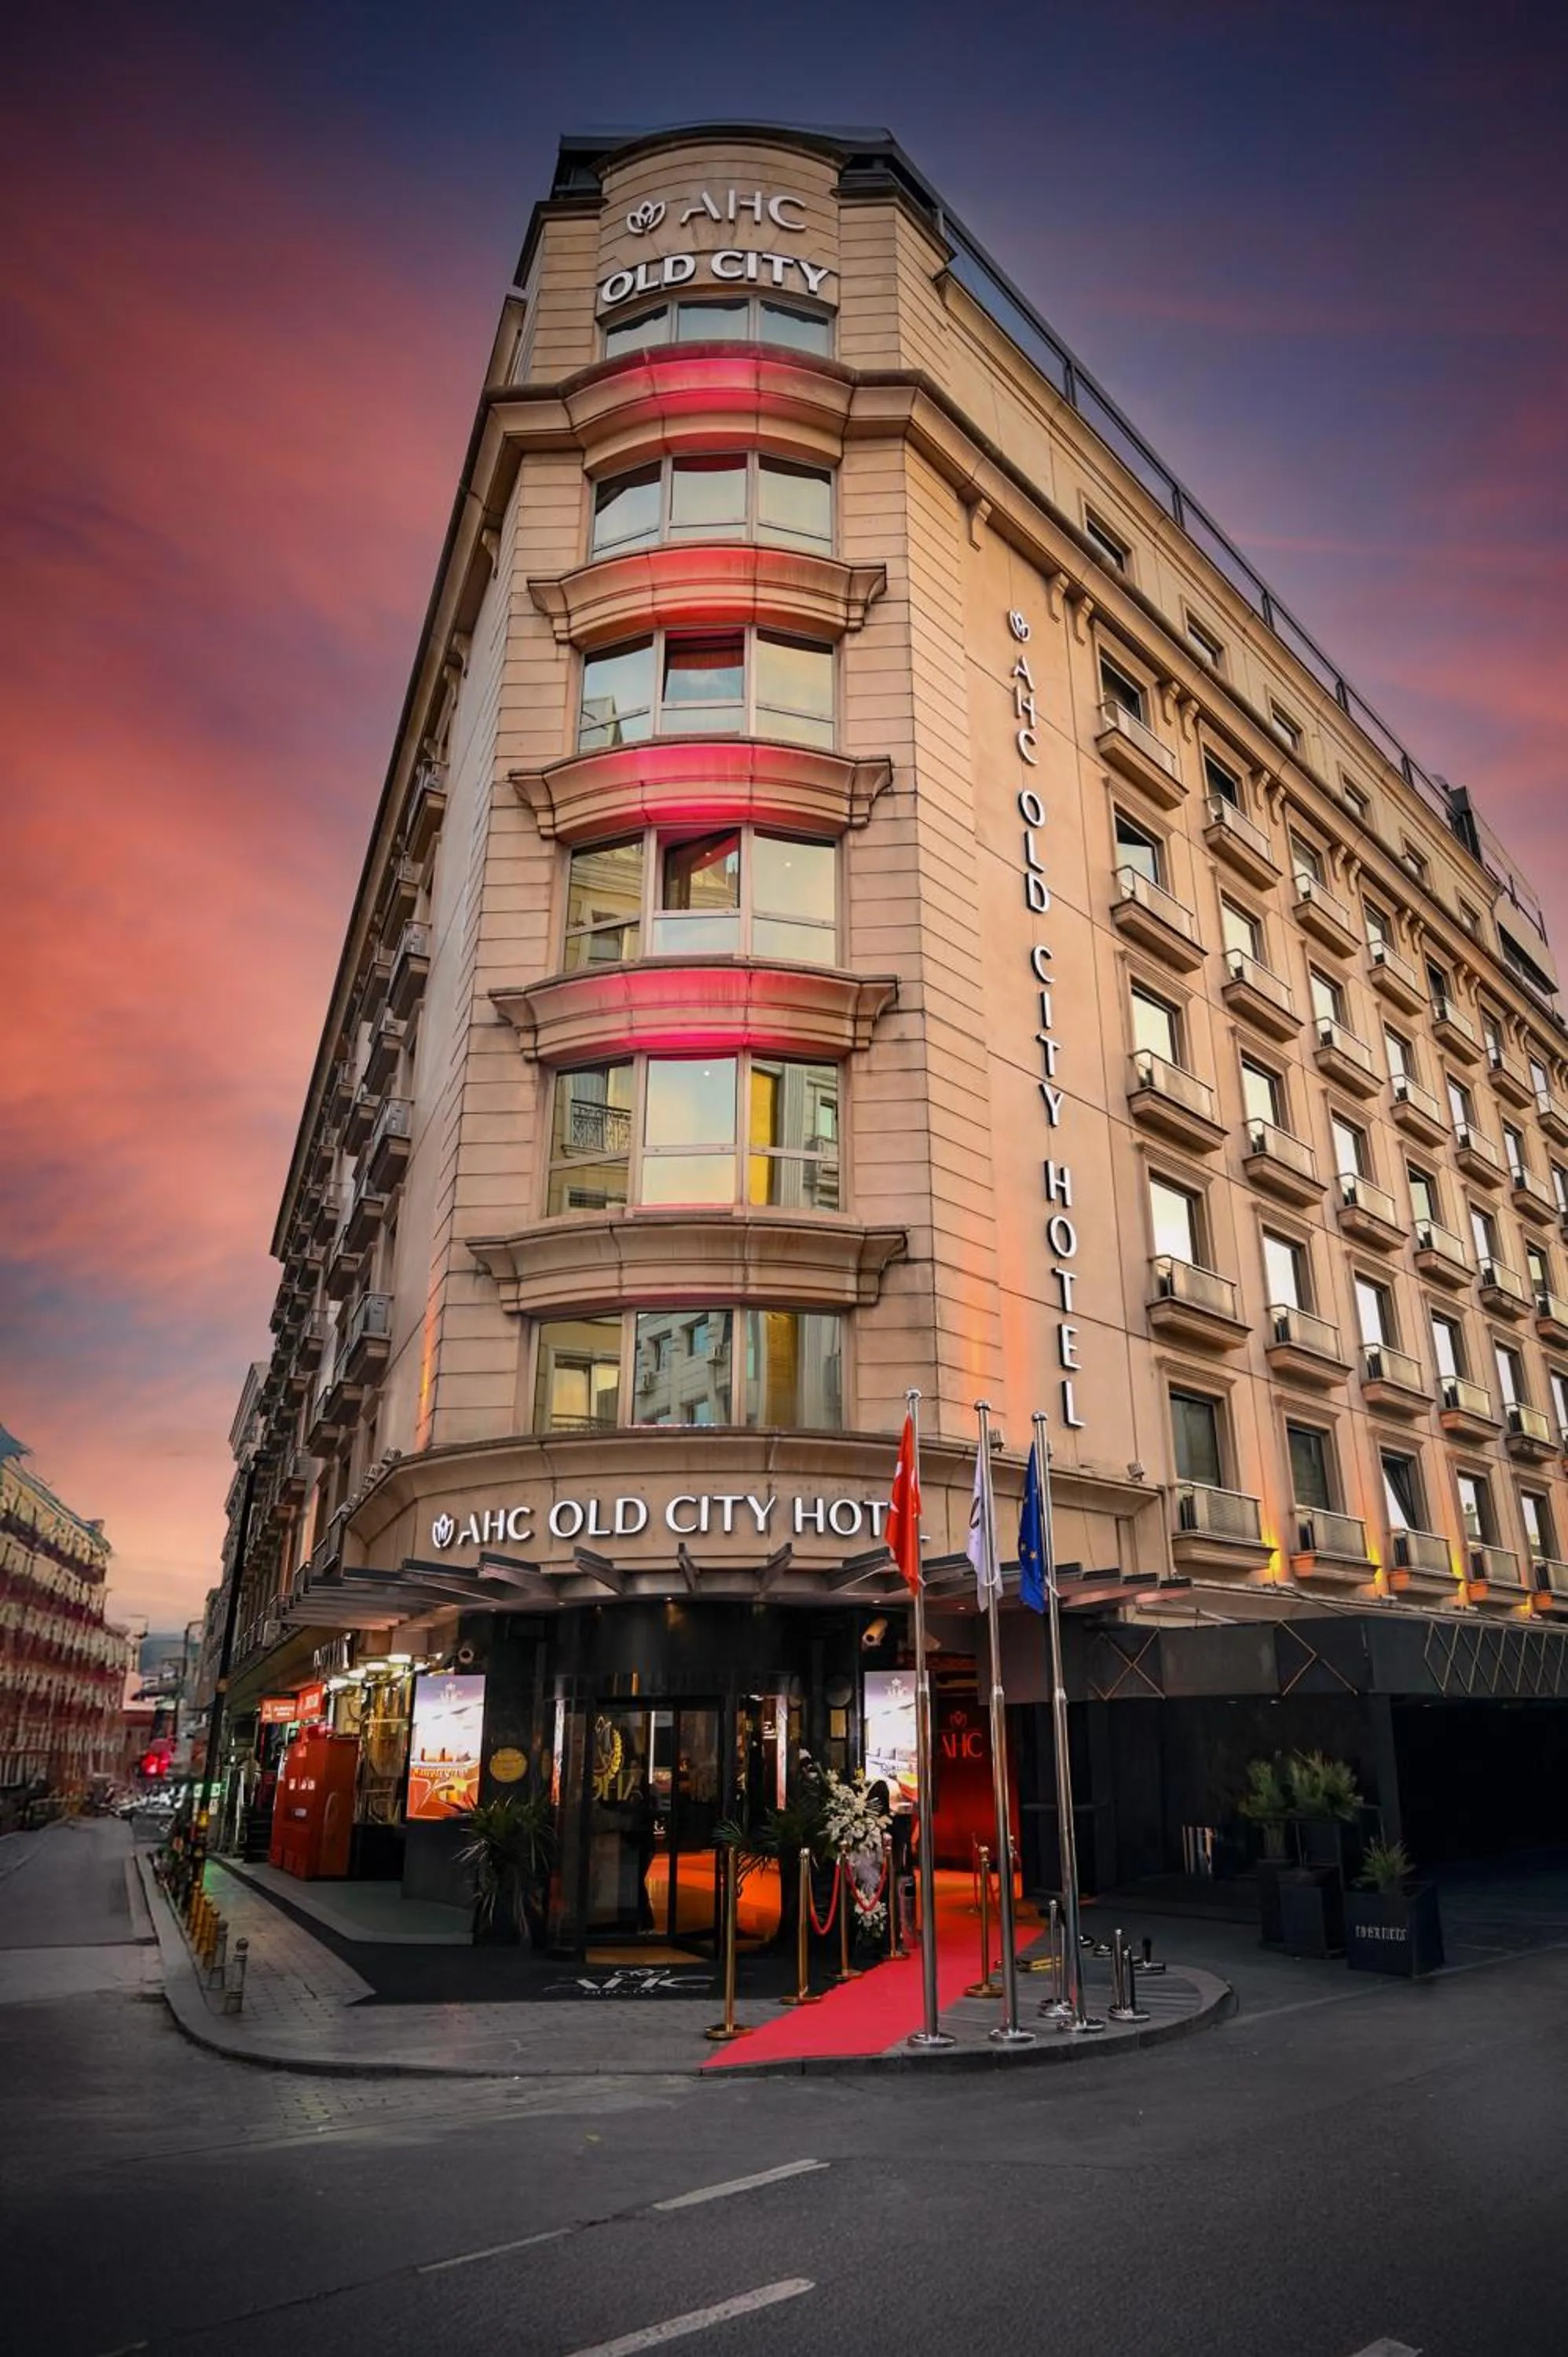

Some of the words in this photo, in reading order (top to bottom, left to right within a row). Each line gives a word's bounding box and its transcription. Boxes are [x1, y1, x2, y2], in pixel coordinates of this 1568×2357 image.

[680, 189, 806, 233] AHC
[600, 253, 696, 305] OLD
[710, 250, 830, 295] CITY
[1010, 655, 1039, 766] AHC
[1019, 790, 1051, 914] OLD
[1031, 945, 1063, 1127] CITY
[1043, 1159, 1087, 1428] HOTEL
[457, 1506, 533, 1545] AHC
[549, 1497, 650, 1539] OLD
[665, 1494, 776, 1533] CITY
[792, 1496, 931, 1540] HOT
[940, 1732, 983, 1758] AHC
